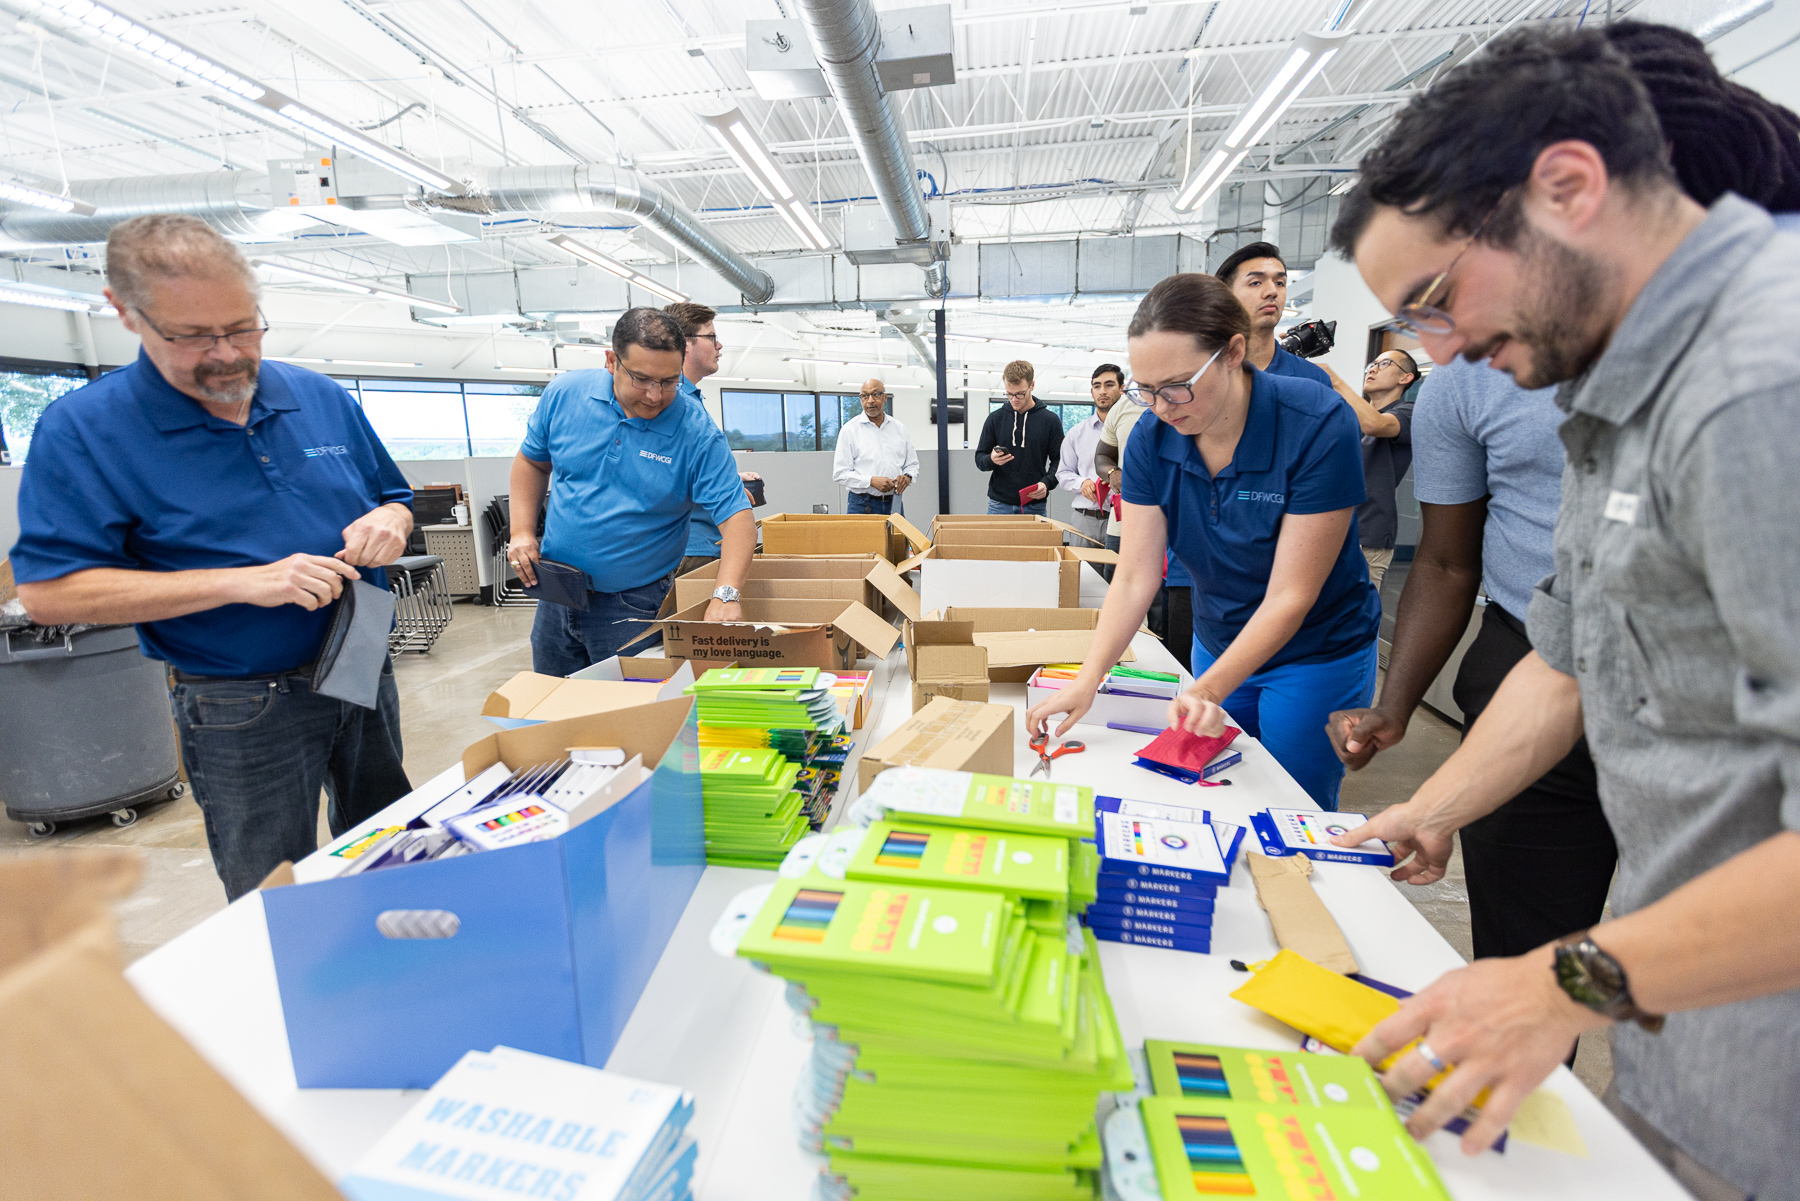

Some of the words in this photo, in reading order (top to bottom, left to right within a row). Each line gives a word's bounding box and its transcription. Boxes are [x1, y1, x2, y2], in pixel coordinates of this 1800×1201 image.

[647, 452, 673, 465] DFWCGI
[1251, 491, 1285, 504] DFWCGI
[692, 635, 714, 646] Fast
[717, 636, 758, 647] delivery
[760, 636, 770, 647] is
[693, 648, 708, 658] my
[710, 647, 731, 657] love
[733, 648, 785, 659] language.
[1326, 854, 1363, 863] MARKERS
[1151, 867, 1192, 881] MARKERS
[1139, 880, 1181, 893] MARKERS
[1137, 895, 1178, 908] MARKERS
[1135, 908, 1176, 921] MARKERS
[1134, 921, 1175, 935] MARKERS
[1133, 935, 1174, 948] MARKERS
[425, 1096, 628, 1160] WASHABLE
[396, 1140, 587, 1201] MARKERS
